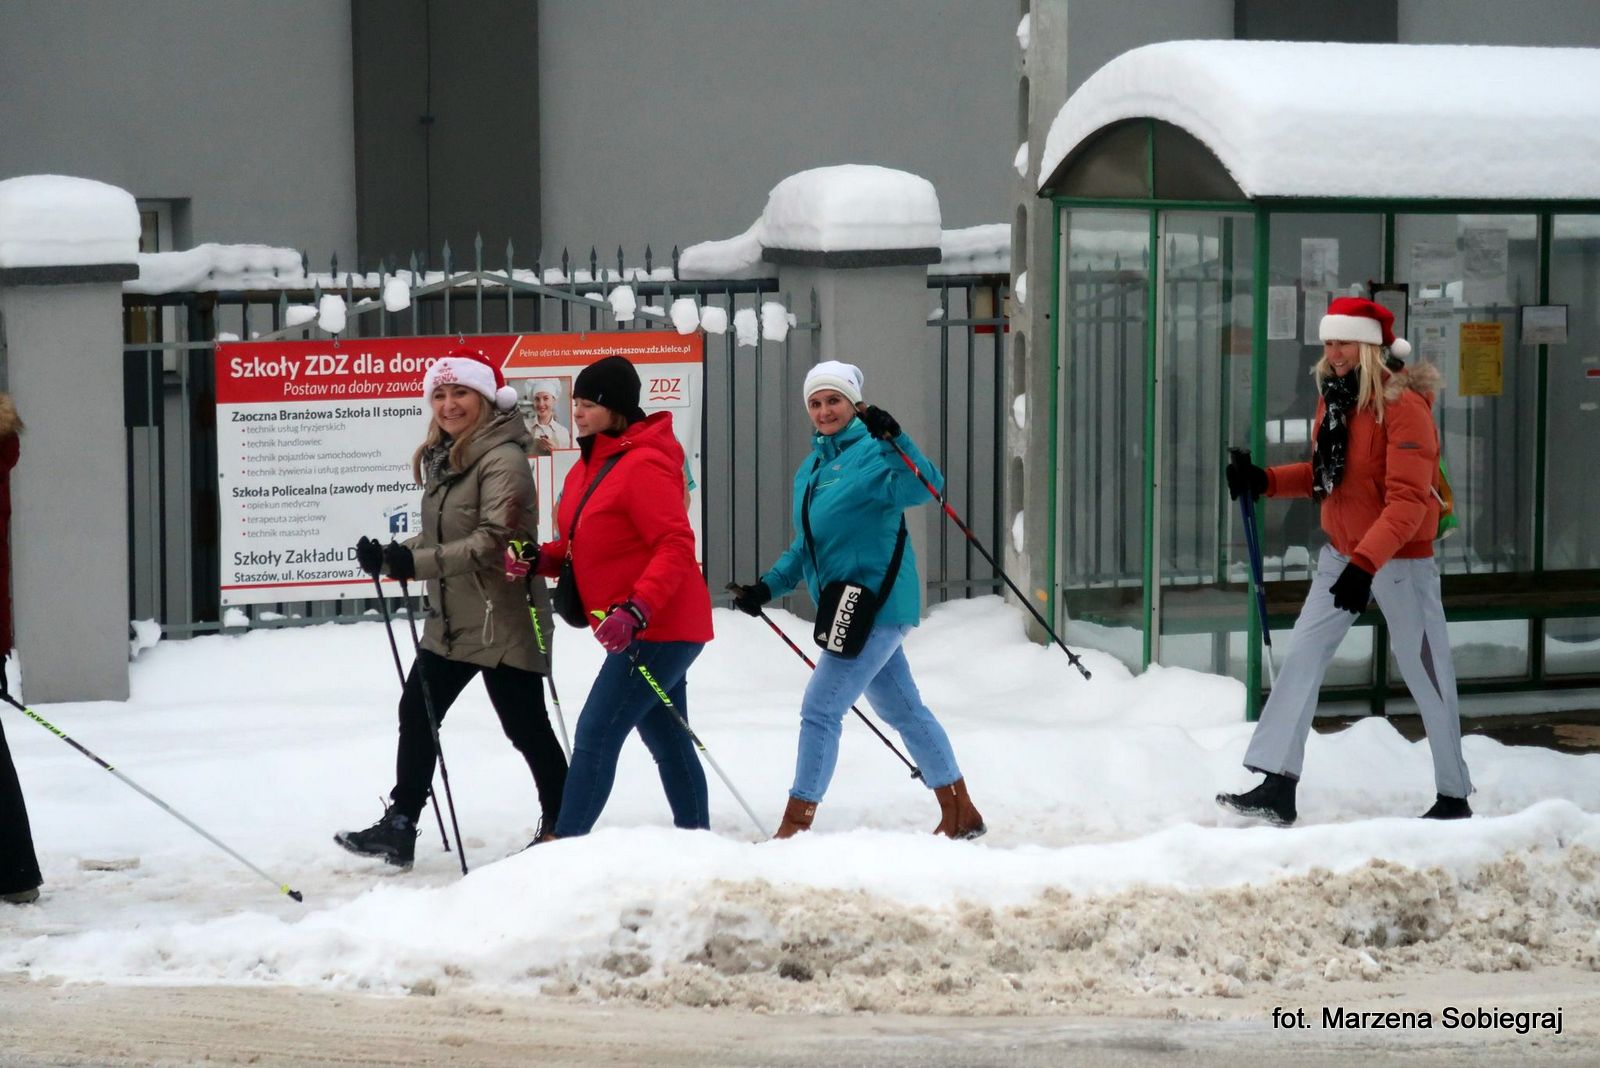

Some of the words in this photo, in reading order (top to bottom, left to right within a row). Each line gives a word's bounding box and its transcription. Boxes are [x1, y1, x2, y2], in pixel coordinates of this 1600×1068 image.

[520, 349, 538, 357] Pełna
[540, 348, 560, 358] oferta
[230, 355, 300, 380] Szkoły
[304, 354, 349, 376] ZDZ
[353, 353, 385, 375] dla
[389, 352, 439, 374] doro
[284, 382, 328, 396] Postaw
[330, 383, 346, 394] na
[348, 380, 384, 395] dobry
[650, 379, 680, 392] ZDZ
[232, 412, 278, 422] Zaoczna
[280, 409, 334, 420] Branżowa
[335, 406, 371, 418] Szkoła
[374, 406, 380, 417] II
[382, 405, 422, 418] stopnia
[246, 426, 276, 434] technik
[300, 422, 346, 433] fryzjerskich
[246, 440, 276, 448] technik
[277, 438, 323, 448] handlowiec
[246, 453, 276, 462] technik
[278, 452, 316, 462] pojazdów
[317, 449, 382, 460] samochodowych
[246, 468, 276, 476] technik
[340, 462, 412, 474] gastronomicznych
[232, 486, 270, 498] Szkoła
[272, 484, 328, 496] Policealna
[330, 482, 374, 496] (zawody
[246, 500, 280, 510] opiekun
[281, 500, 320, 509] medyczny
[247, 516, 287, 524] terapeuta
[247, 529, 277, 538] technik
[234, 551, 282, 567] Szkoły
[285, 548, 344, 564] Zakładu
[348, 547, 358, 560] D
[234, 571, 280, 583] Staszów,
[282, 570, 294, 581] ul.
[296, 569, 354, 580] Koszarowa
[834, 592, 861, 647] adidas
